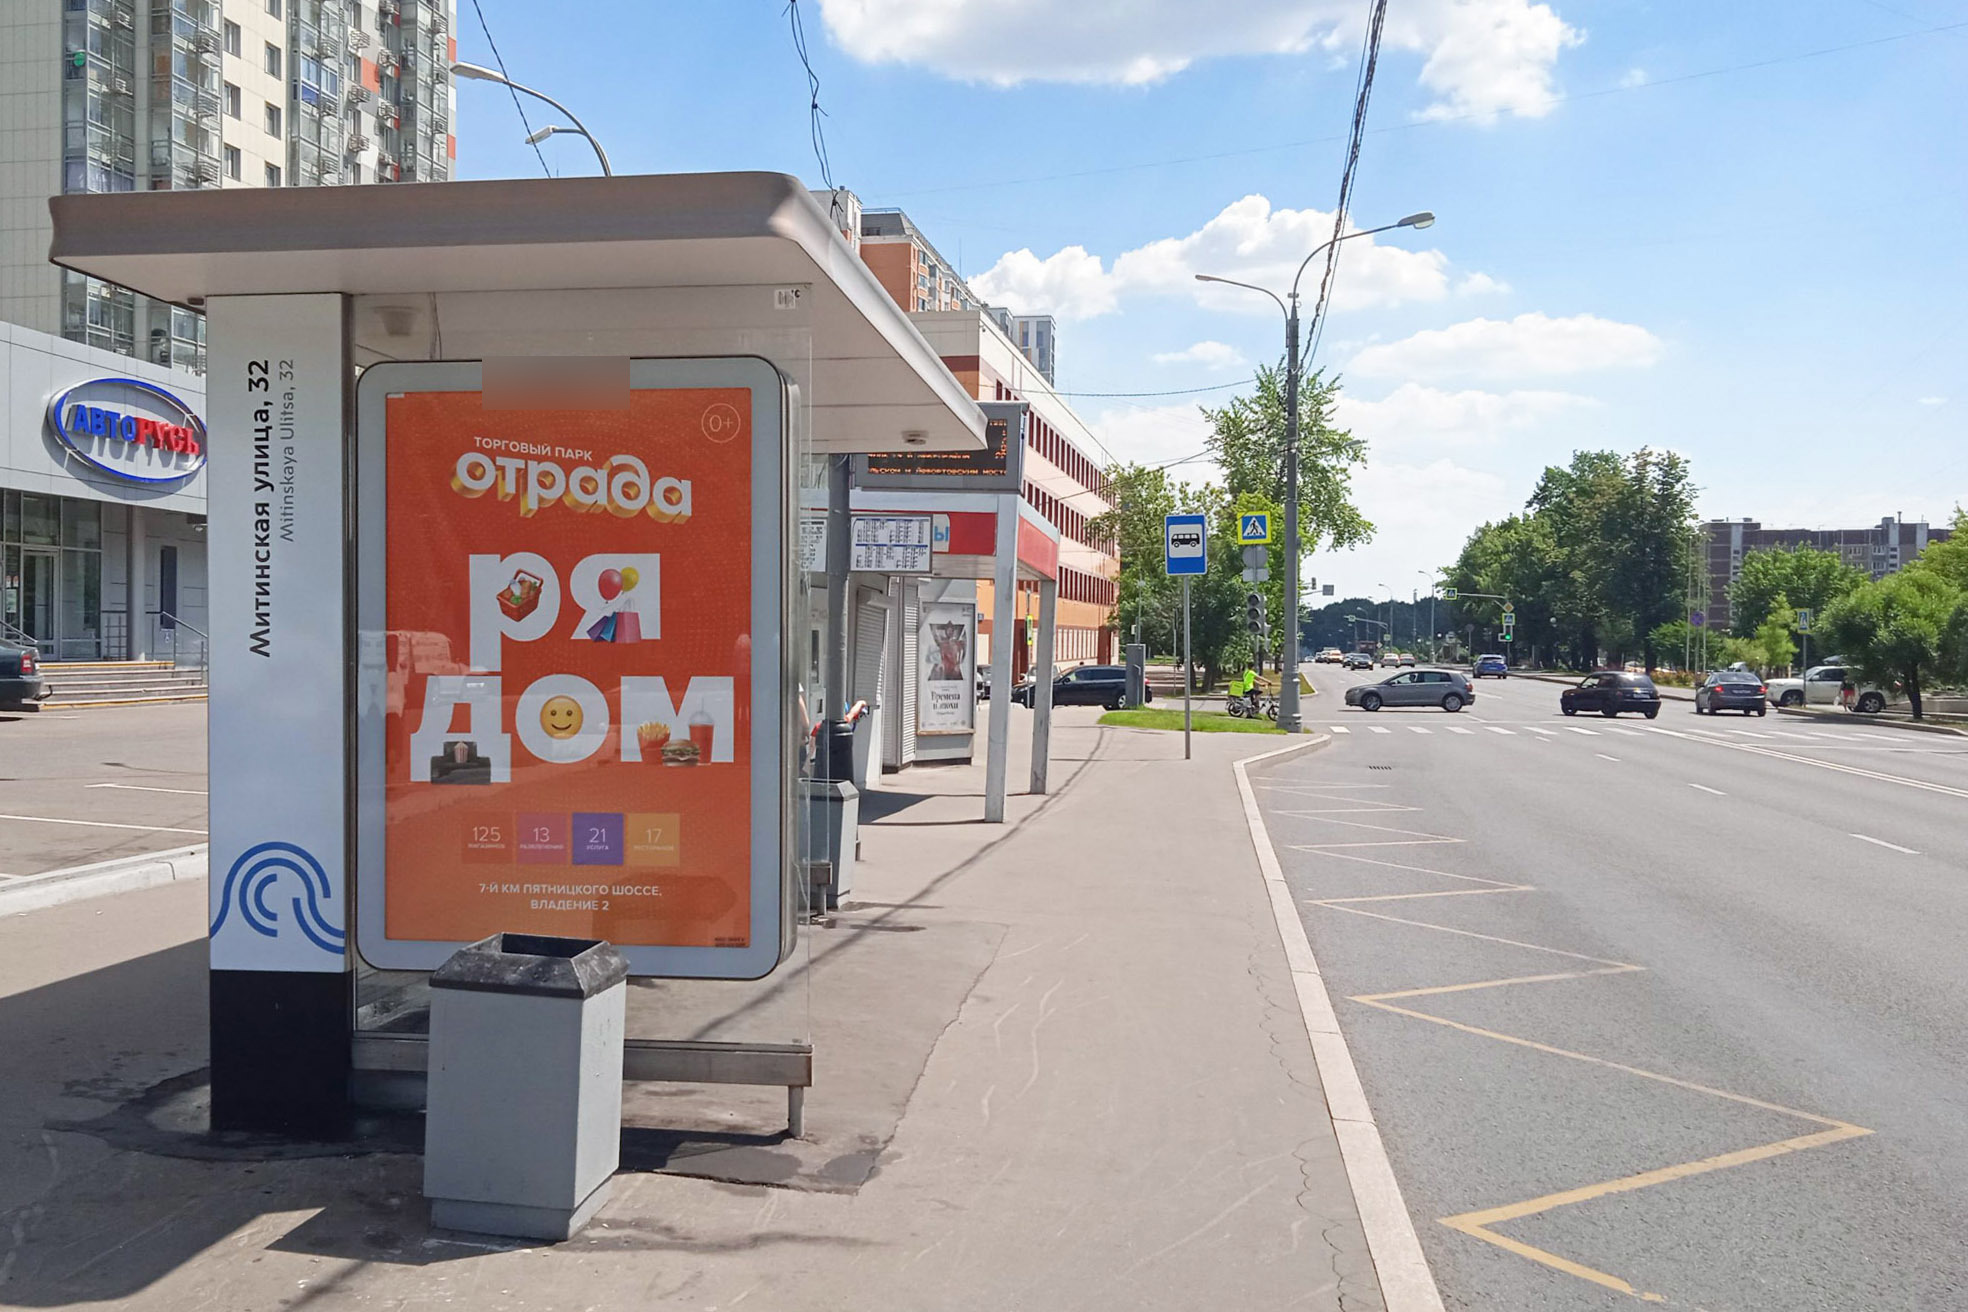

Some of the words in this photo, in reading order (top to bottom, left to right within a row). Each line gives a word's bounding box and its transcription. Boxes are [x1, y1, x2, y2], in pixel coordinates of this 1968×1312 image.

[248, 360, 269, 392] 32
[279, 359, 294, 381] 32
[280, 386, 296, 440] Ulitsa,
[709, 414, 733, 432] 0+
[73, 404, 200, 455] АВТОРУСЬ
[254, 401, 274, 492] улица,
[474, 436, 551, 456] ТОРГОВЫЙ
[555, 446, 593, 461] ПАРК
[279, 446, 297, 542] Mitinskaya
[249, 503, 271, 658] Митинская
[472, 827, 501, 842] 125
[533, 827, 550, 842] 13
[589, 828, 606, 843] 21
[646, 829, 662, 843] 17
[479, 883, 498, 893] 7-Й
[502, 884, 520, 893] КМ
[523, 884, 609, 895] ПЯТНИЦКОГО
[531, 900, 598, 911] ВЛАДЕНИЕ
[602, 902, 609, 911] 2
